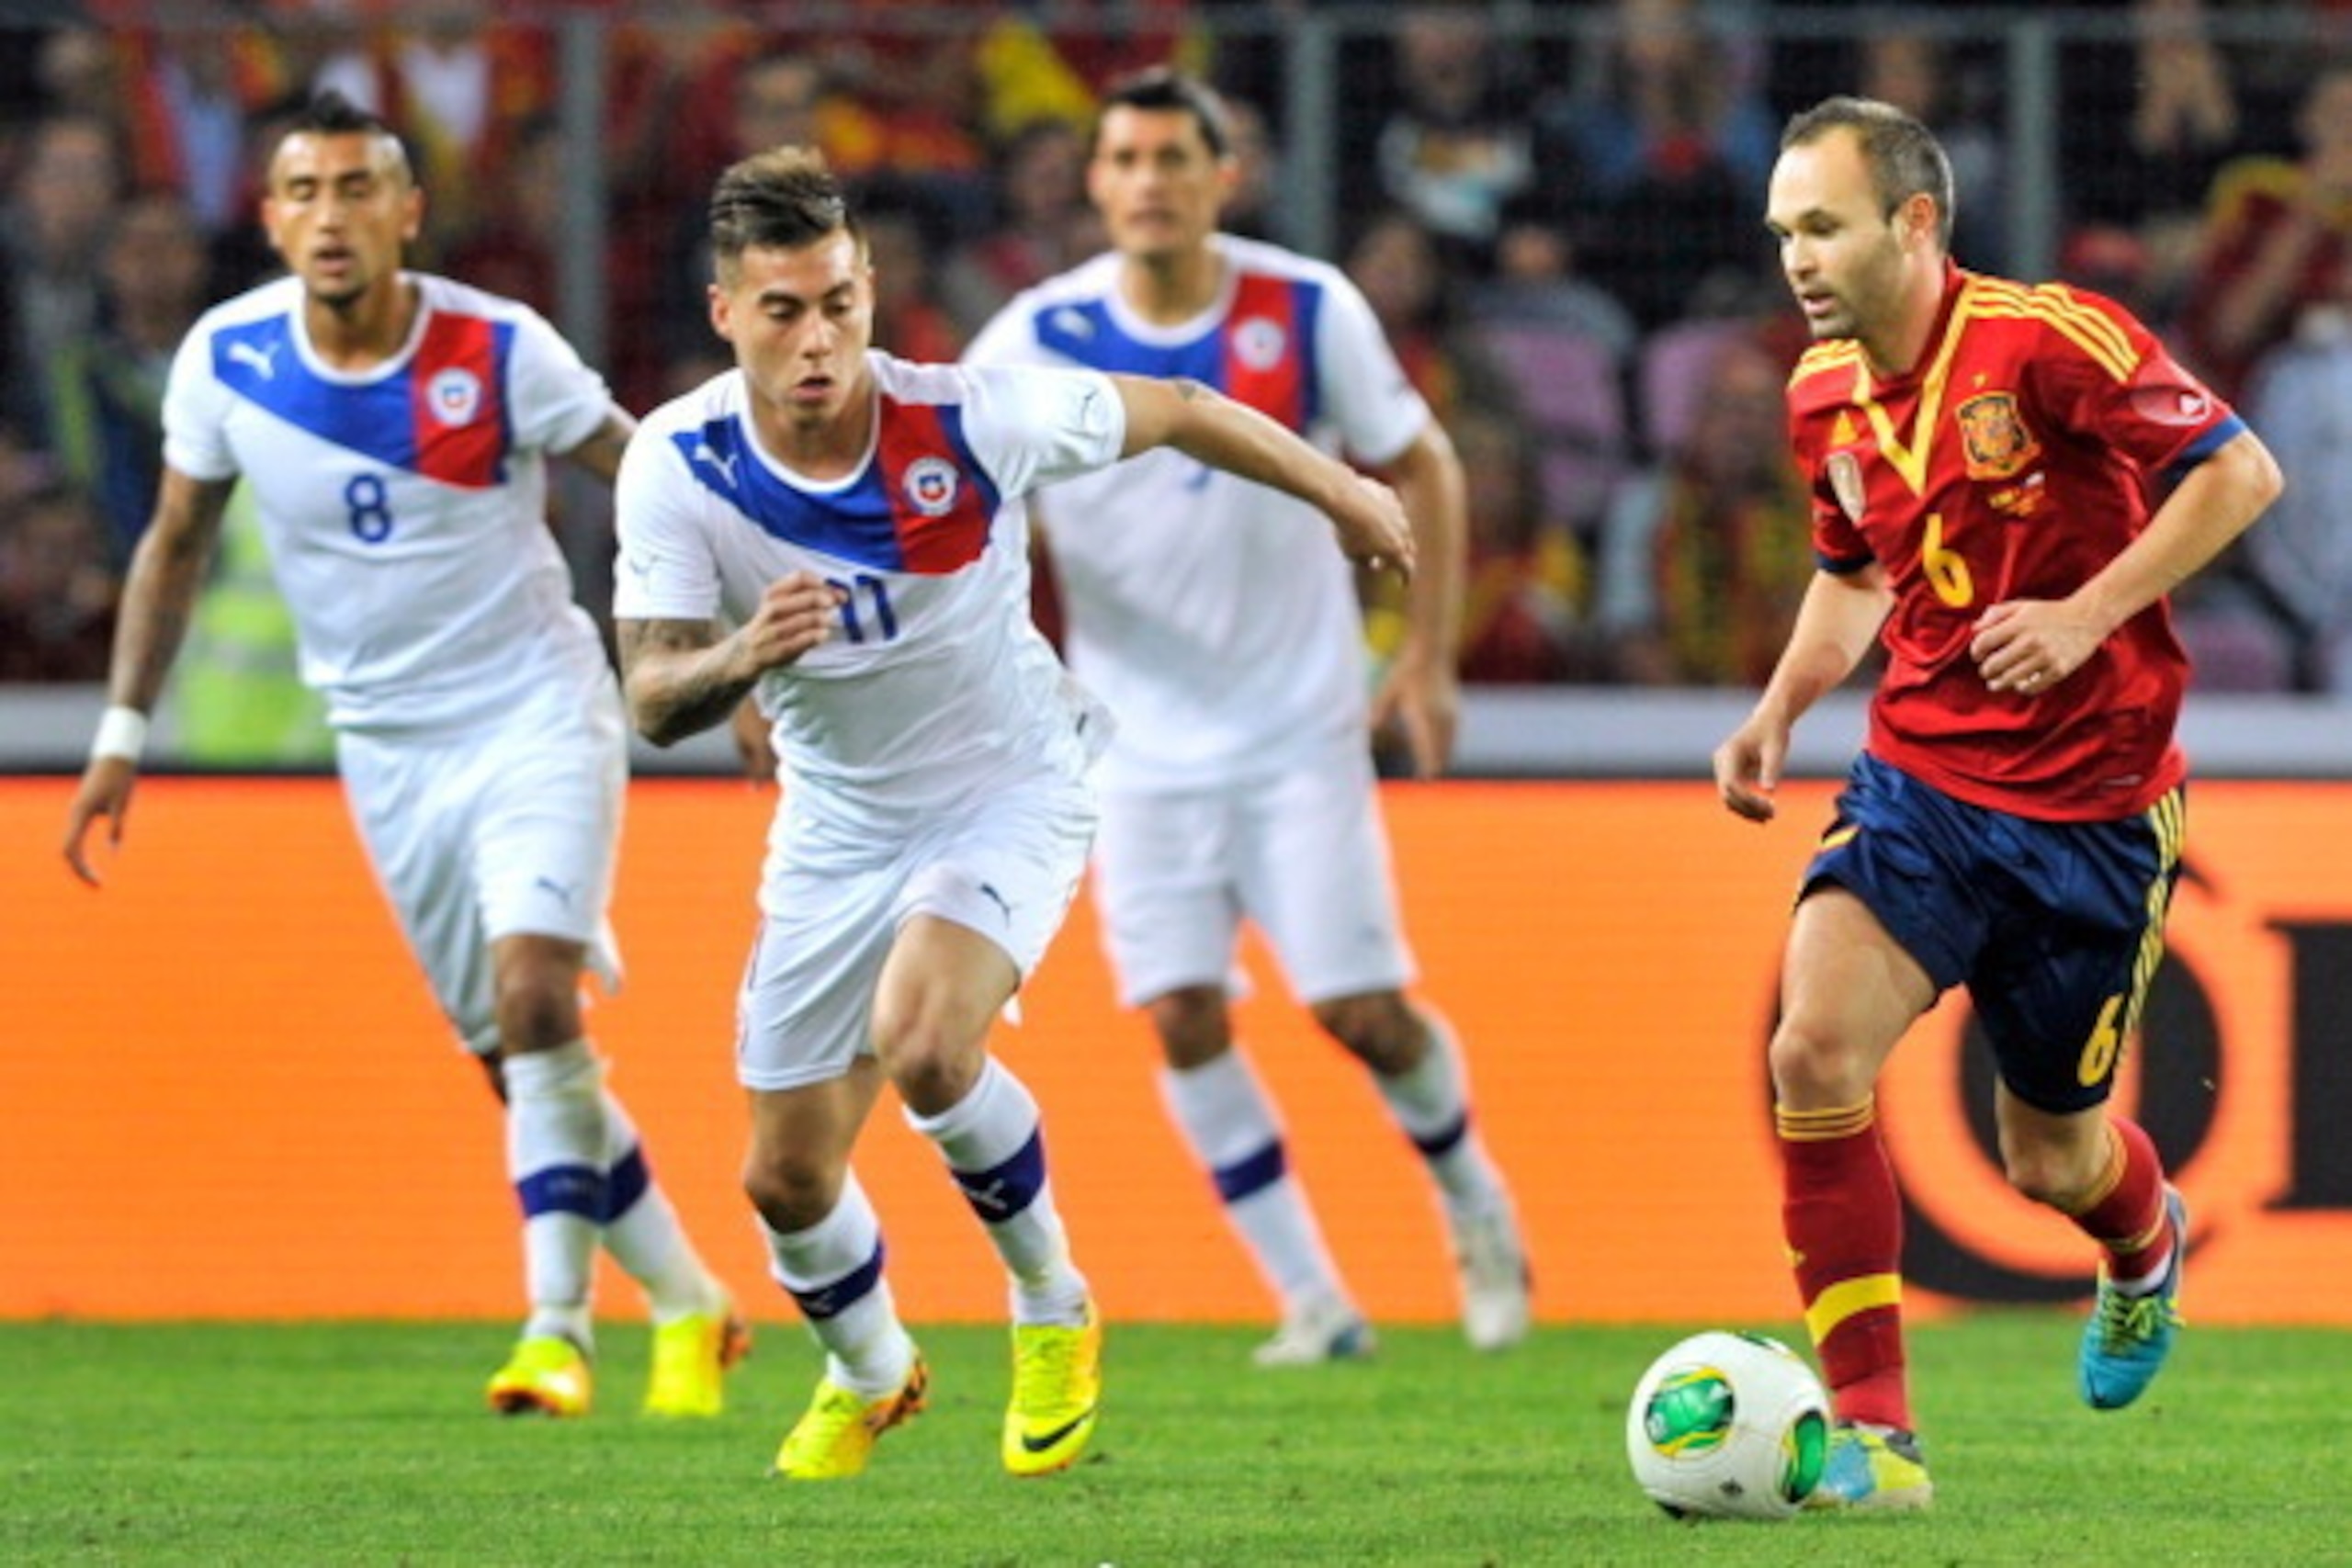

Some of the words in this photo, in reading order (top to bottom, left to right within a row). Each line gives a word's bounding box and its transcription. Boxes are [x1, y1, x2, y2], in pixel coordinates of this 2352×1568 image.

[345, 472, 393, 544] 8
[1923, 513, 1973, 608] 6
[825, 575, 898, 644] 11
[2077, 993, 2123, 1088] 6
